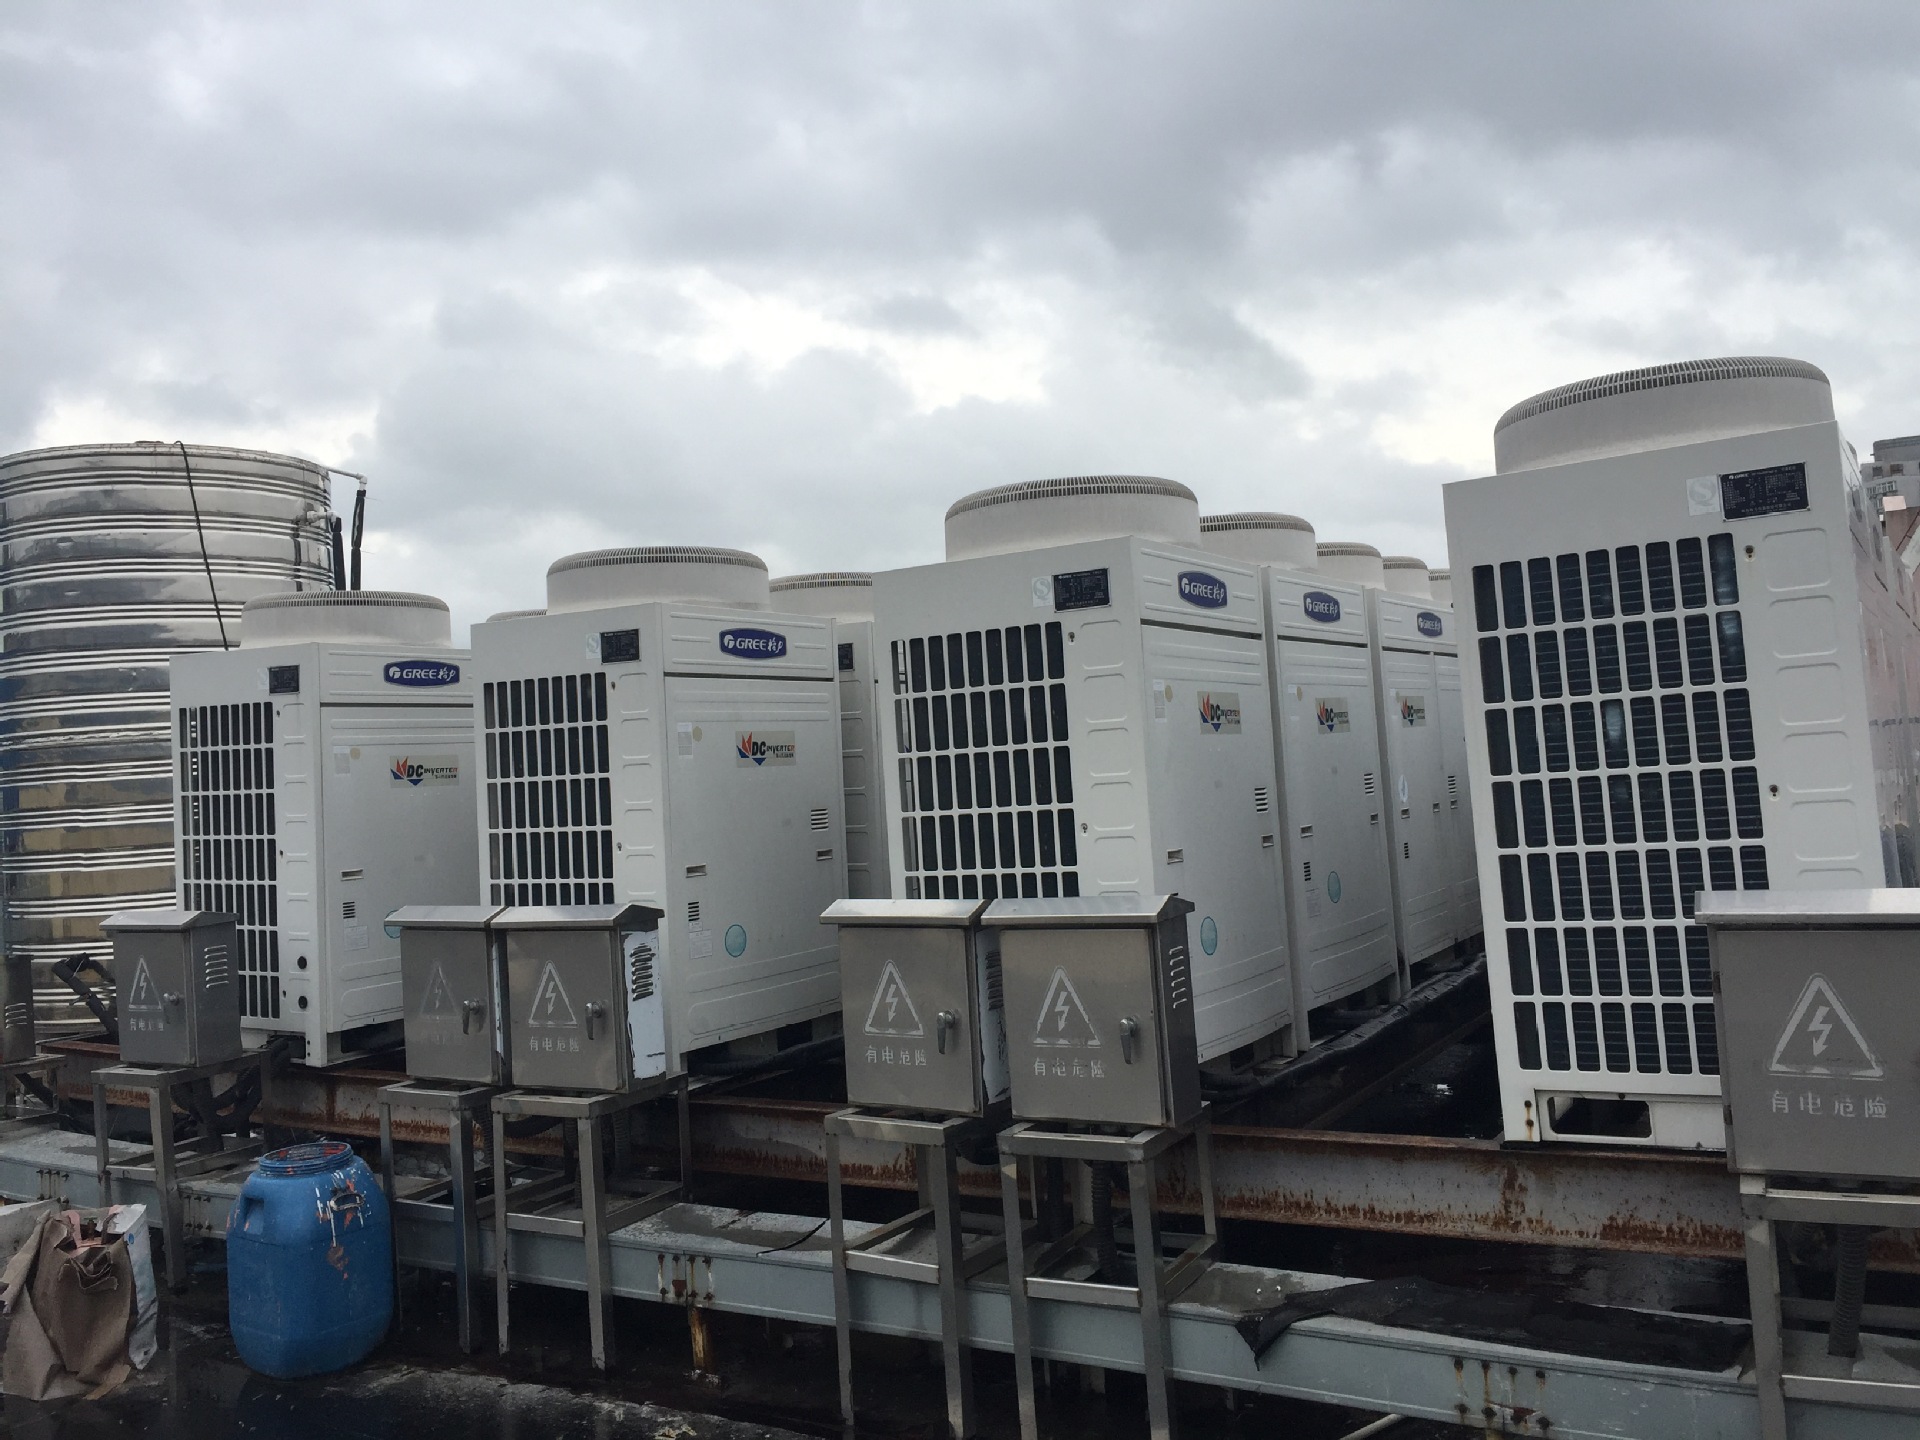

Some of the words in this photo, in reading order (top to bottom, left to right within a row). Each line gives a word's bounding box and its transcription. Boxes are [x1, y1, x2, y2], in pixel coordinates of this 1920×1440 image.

[1190, 582, 1213, 599] GREE
[1312, 601, 1329, 614] GREE
[736, 638, 767, 651] GREE
[402, 668, 437, 679] GREE
[1210, 703, 1220, 722] DC
[1325, 708, 1334, 723] DC
[751, 741, 767, 757] DC
[406, 764, 424, 778] DC
[423, 766, 458, 776] INVERTER
[865, 1044, 927, 1066] 有电危险
[1033, 1057, 1105, 1078] 有电危险
[1771, 1089, 1888, 1119] 有电危险
